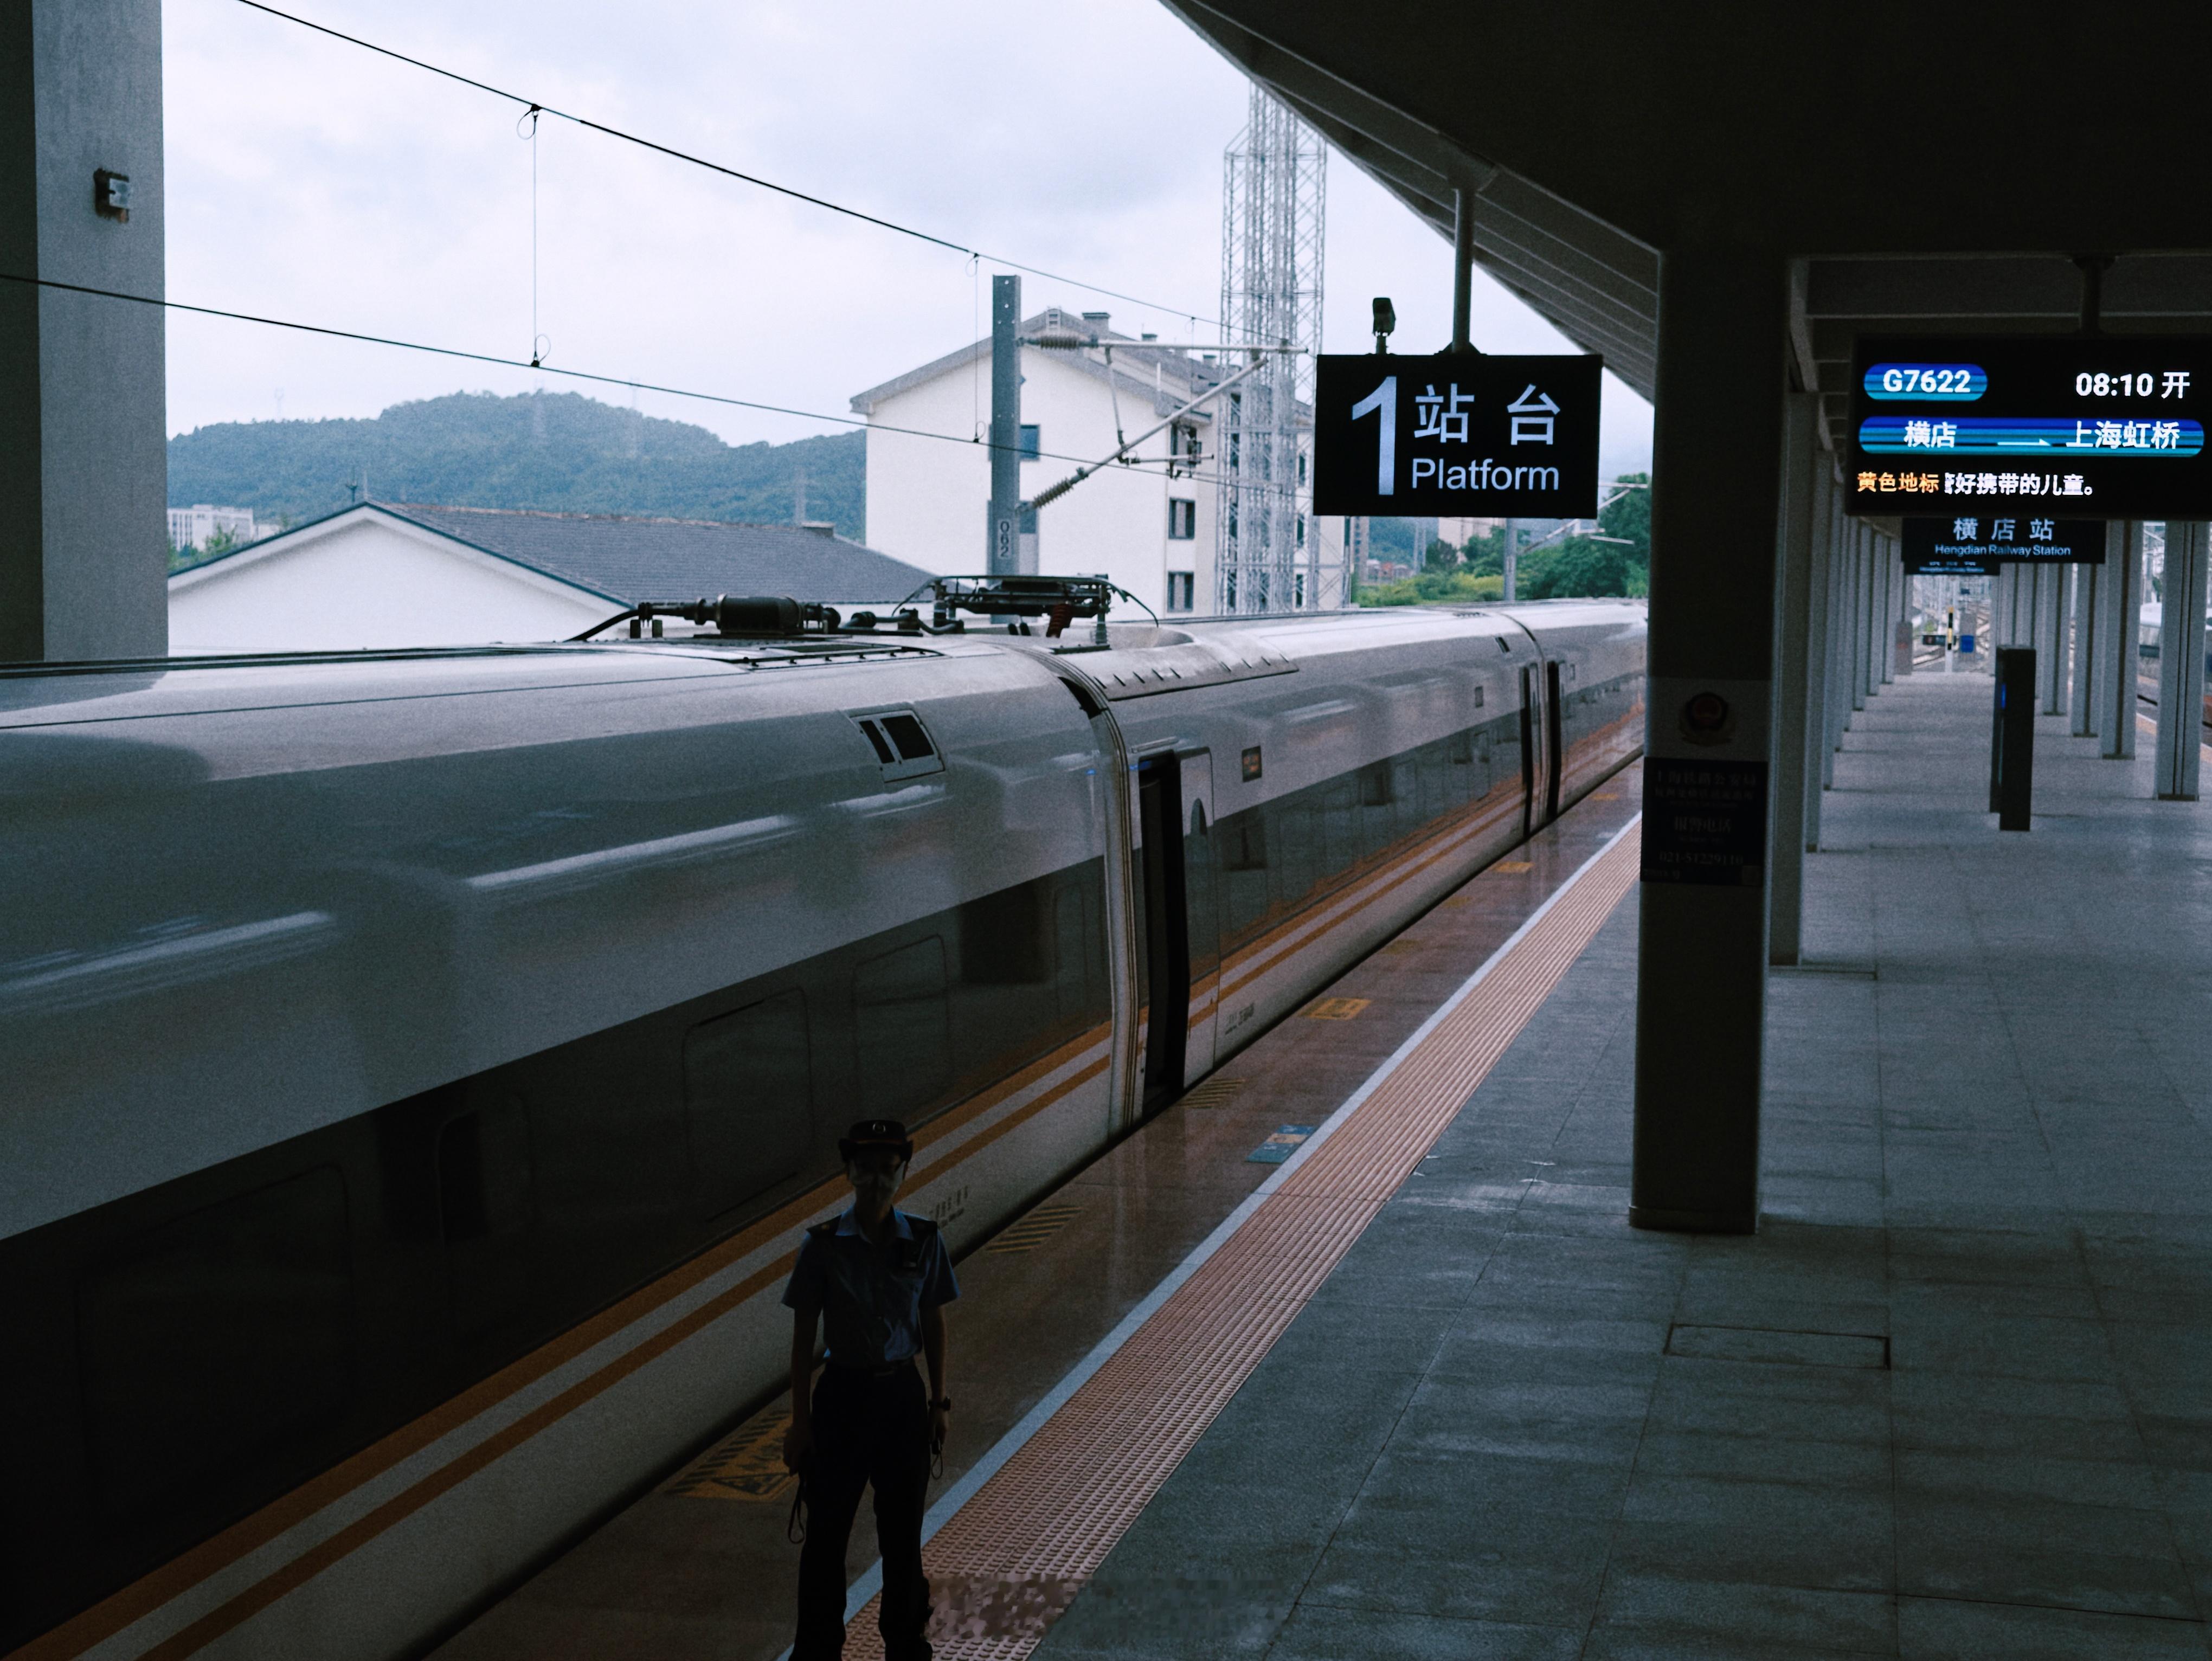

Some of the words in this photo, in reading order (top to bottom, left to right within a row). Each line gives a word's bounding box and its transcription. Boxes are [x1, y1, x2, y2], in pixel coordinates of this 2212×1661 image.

[1883, 369, 1971, 392] G7622
[2076, 372, 2153, 397] 08:10
[2161, 372, 2190, 399] 开
[1352, 376, 1397, 495] 1
[1414, 383, 1560, 446] 站台
[1904, 420, 1957, 448] 横店
[2066, 420, 2180, 449] 上海虹桥
[1412, 458, 1559, 490] Platform
[1857, 471, 1940, 493] 黄色地标
[1953, 518, 2055, 541] 横店站
[1935, 544, 1986, 557] Hengdian
[1989, 544, 2031, 557] Railway
[2033, 544, 2070, 555] Station
